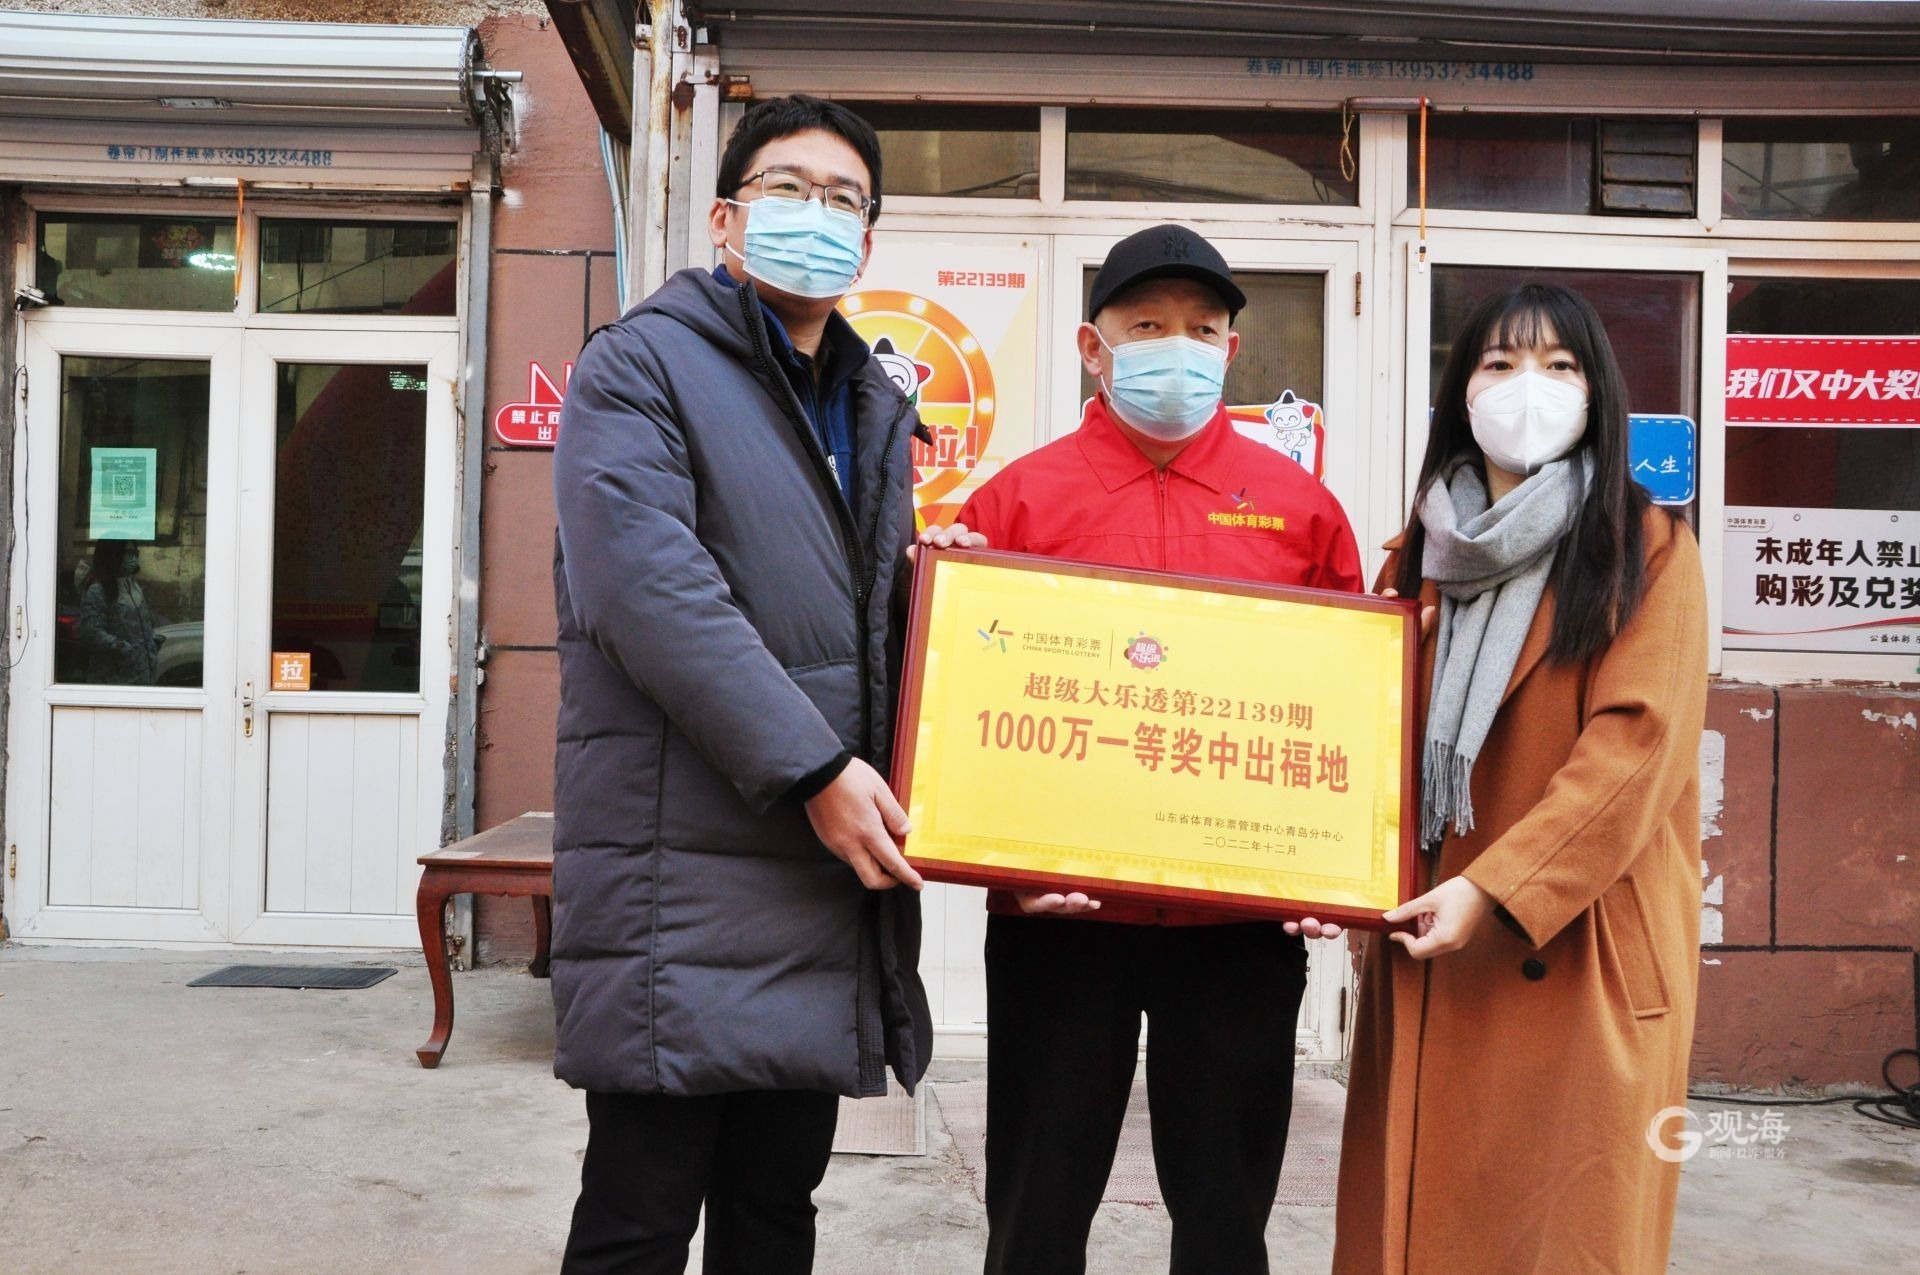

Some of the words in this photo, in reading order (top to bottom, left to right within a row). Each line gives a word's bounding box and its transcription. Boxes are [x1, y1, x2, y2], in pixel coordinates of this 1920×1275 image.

[938, 271, 1025, 288] 第22139期
[1725, 368, 1920, 400] 我们又中大奖
[1208, 512, 1285, 531] 中国体育彩票
[1023, 631, 1102, 650] 中国体育彩票
[1044, 647, 1069, 655] SPORTS
[1071, 650, 1101, 658] LOTTERY
[281, 660, 303, 680] 拉
[1023, 672, 1313, 731] 超级大乐透第22139期
[977, 710, 1350, 794] 1000万一等奖中出福地
[1155, 811, 1344, 842] 山东省体育彩票管理中心青岛分中心
